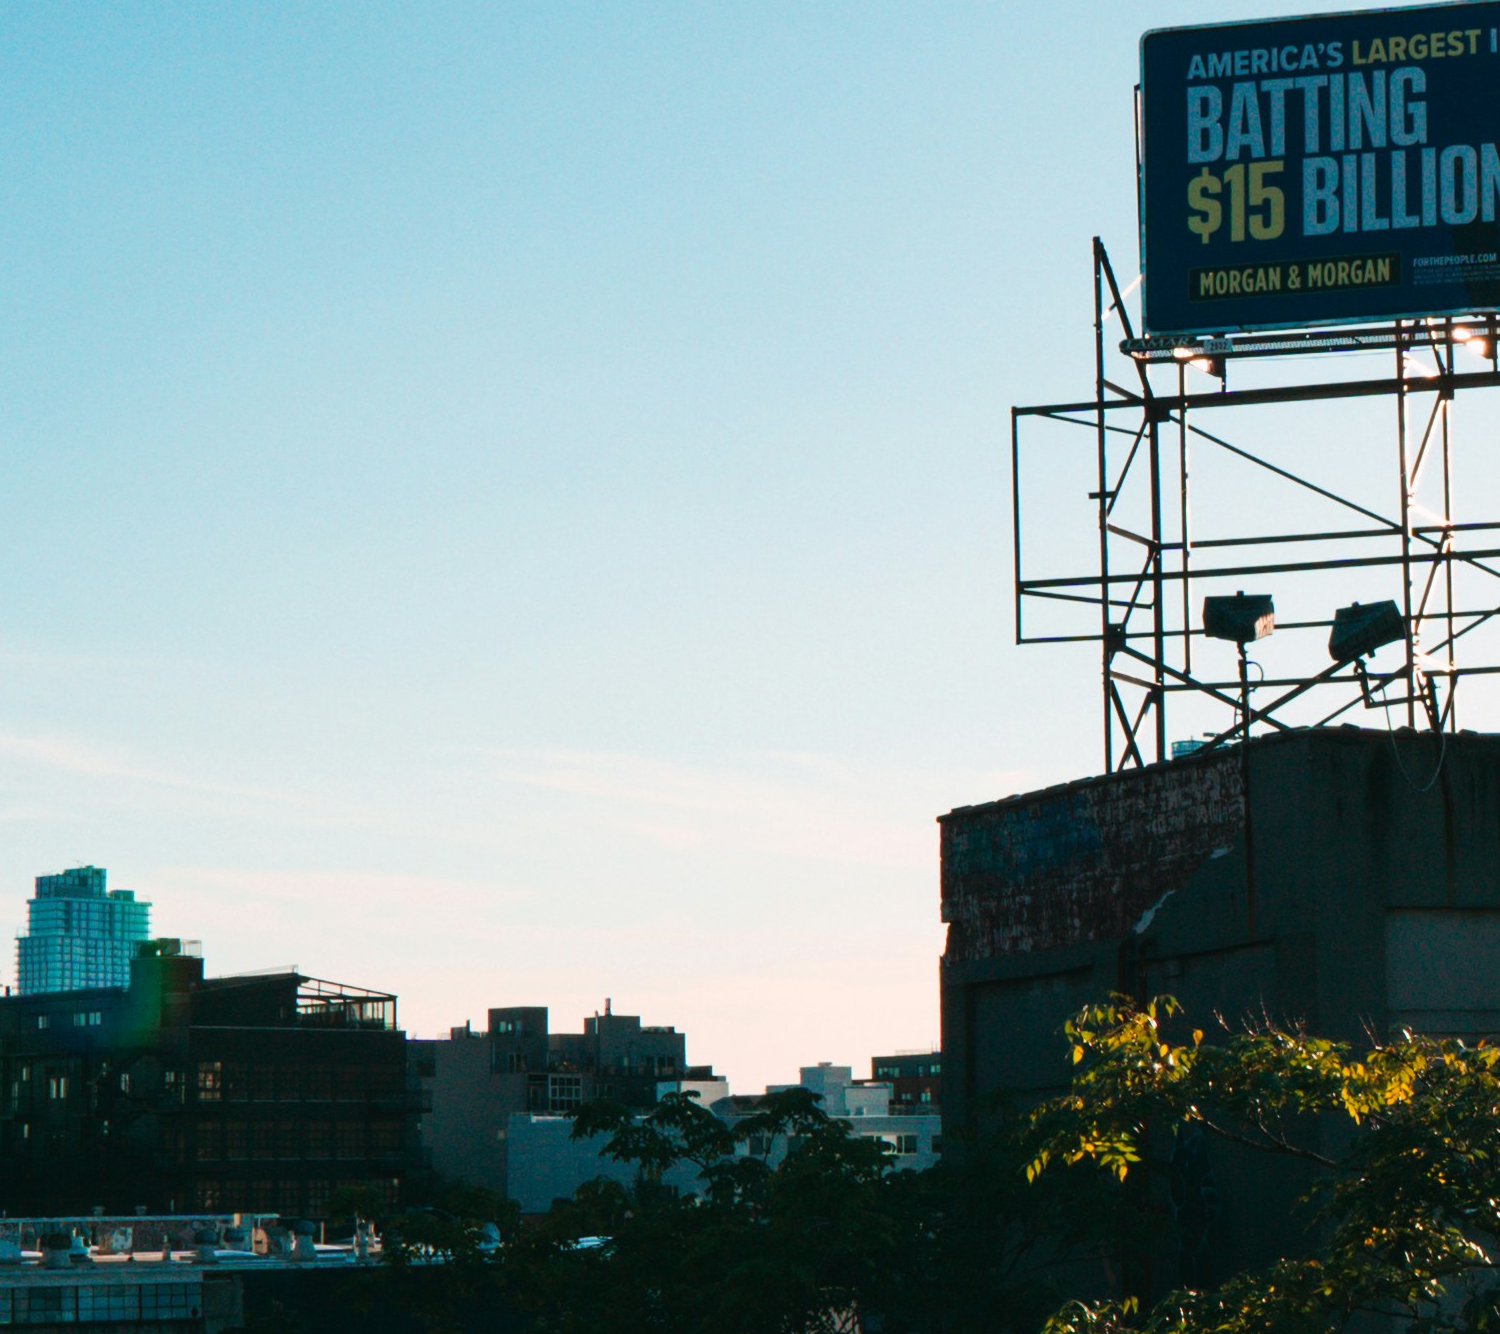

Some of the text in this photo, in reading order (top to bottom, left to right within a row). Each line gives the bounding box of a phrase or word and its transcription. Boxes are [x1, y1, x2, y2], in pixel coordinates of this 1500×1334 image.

[1187, 41, 1343, 80] AMERICA'S
[1352, 29, 1481, 66] LARGEST
[1187, 66, 1428, 164] BATTING
[1187, 160, 1285, 245] $15
[1200, 267, 1281, 296] MORGAN
[1287, 265, 1301, 289] &
[1307, 257, 1390, 288] MORGAN
[1413, 253, 1496, 267] FORTHEPEOPLE.COM
[1126, 336, 1191, 349] LAMAR
